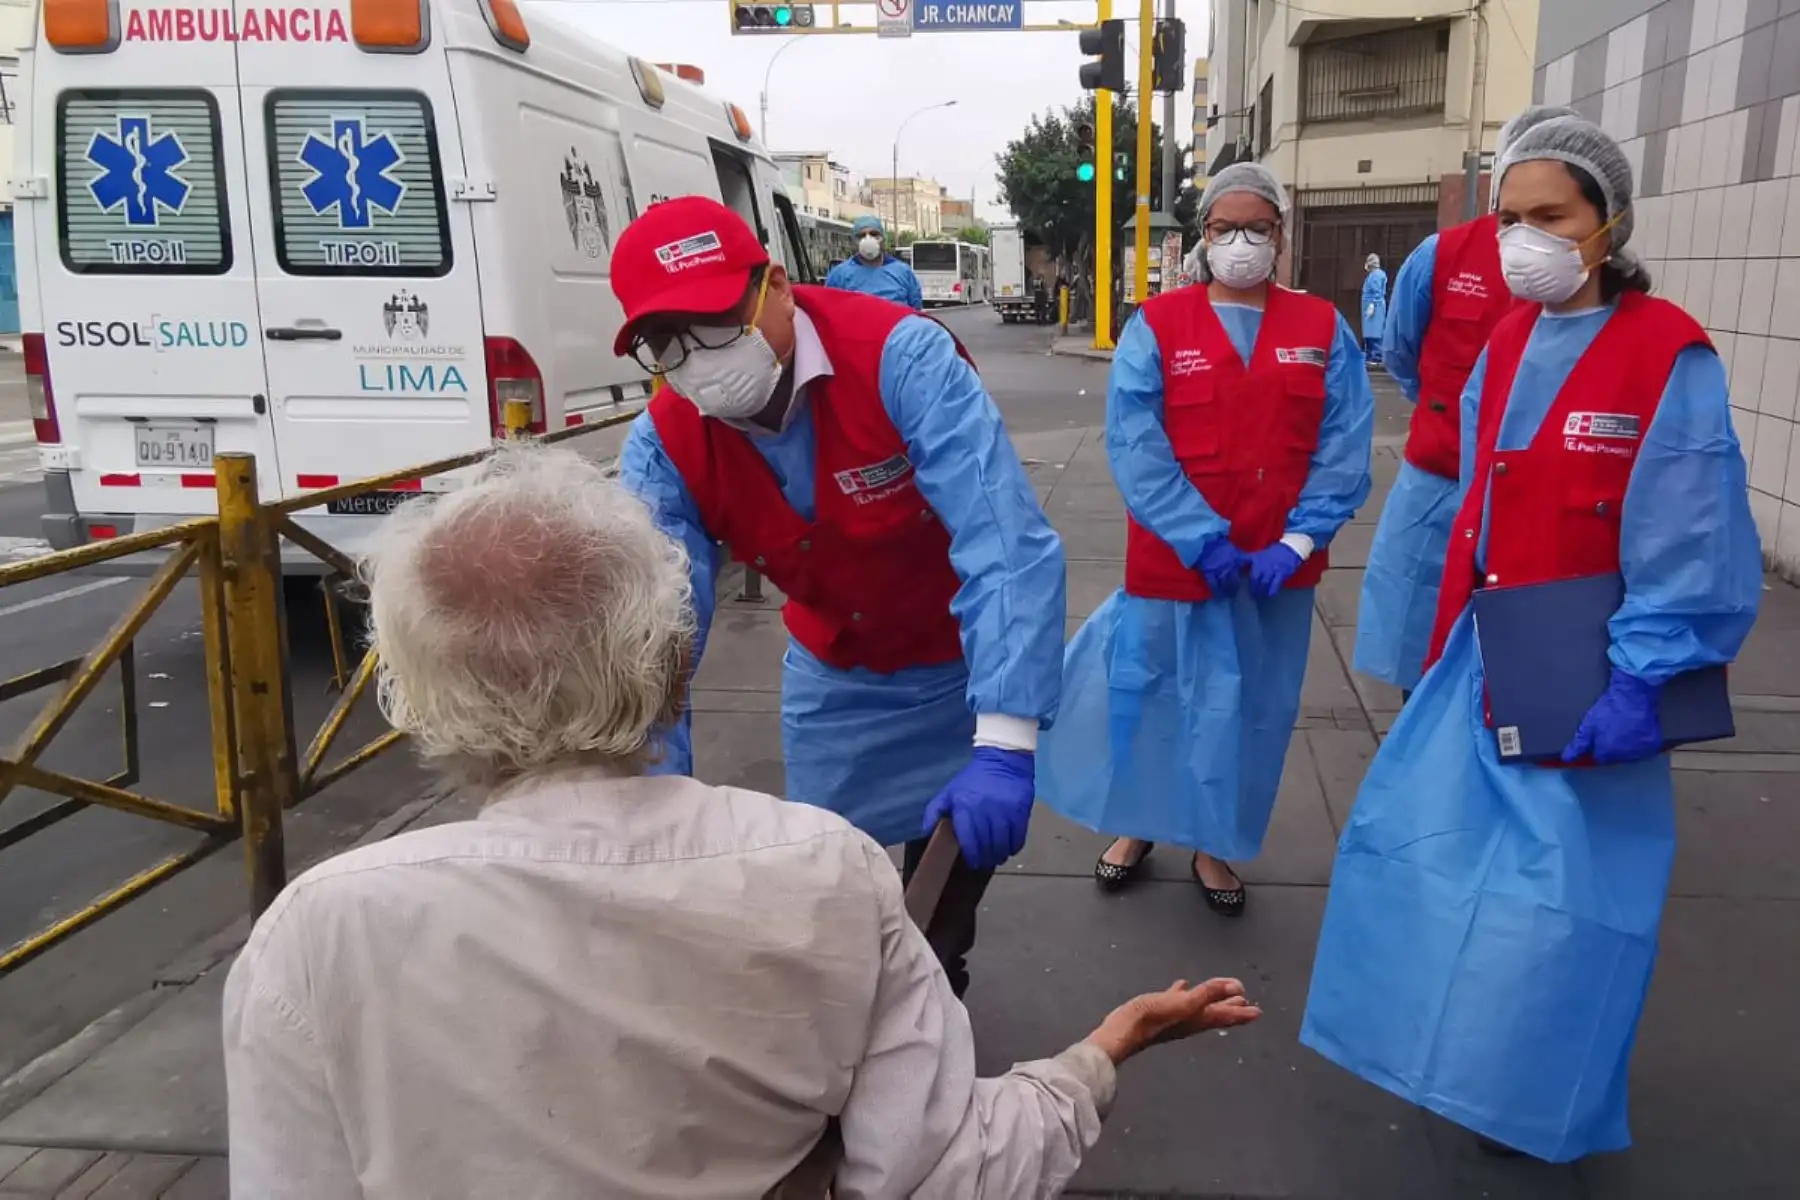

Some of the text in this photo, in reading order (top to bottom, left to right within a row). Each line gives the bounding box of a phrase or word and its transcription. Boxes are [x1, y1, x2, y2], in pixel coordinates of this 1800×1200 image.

[125, 8, 349, 42] AMBULANCIA
[920, 4, 1014, 23] JR. CHANCAY
[109, 241, 165, 264] TIPO
[322, 242, 380, 264] TIPO
[57, 321, 248, 347] SISOL SALUD
[353, 344, 446, 355] MUNICIPALIDAD
[359, 364, 468, 392] LIMA
